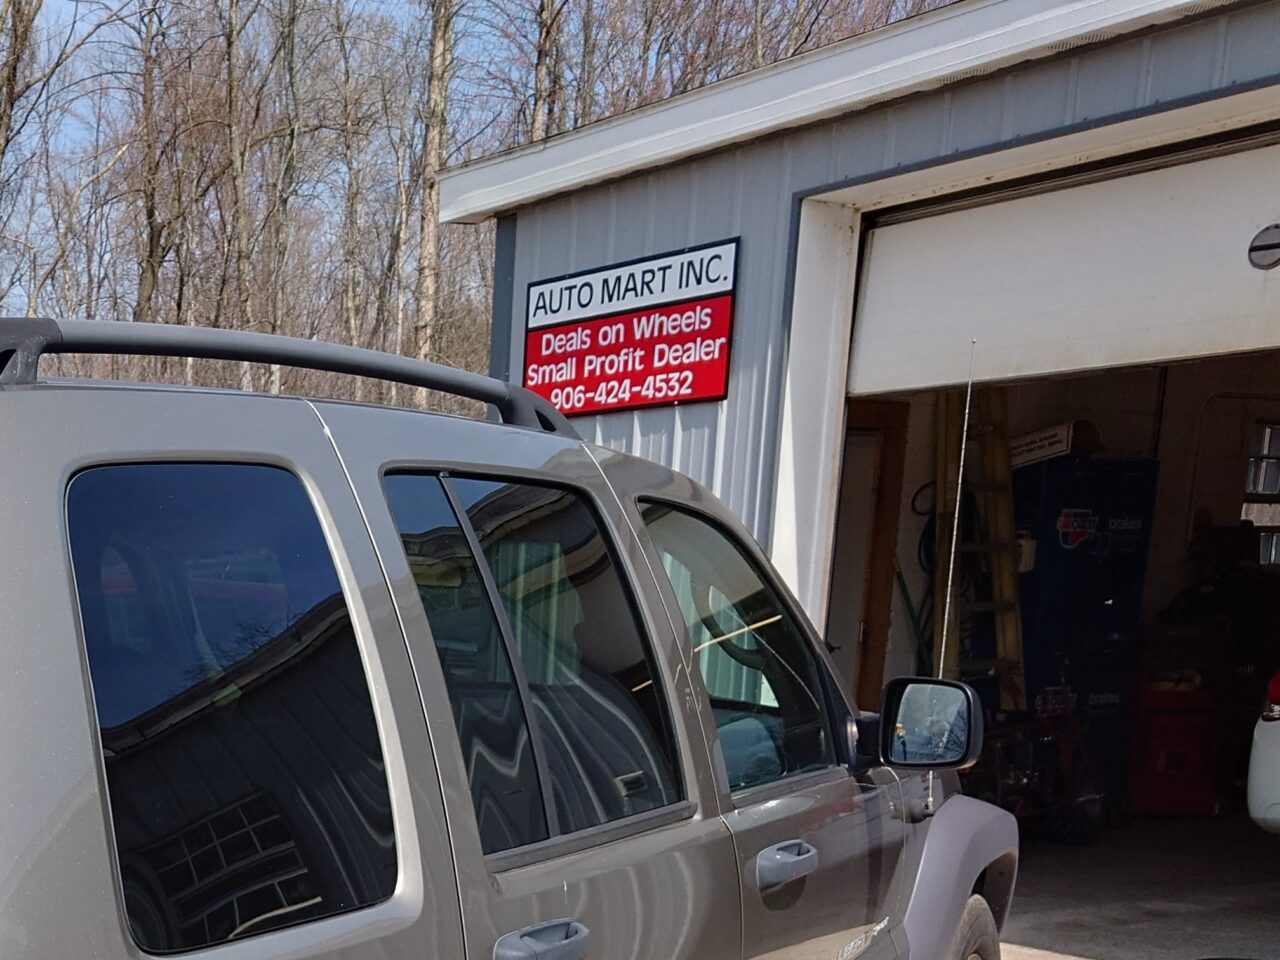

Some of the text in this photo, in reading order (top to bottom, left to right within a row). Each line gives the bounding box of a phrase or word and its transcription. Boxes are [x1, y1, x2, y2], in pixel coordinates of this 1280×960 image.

[532, 254, 728, 318] AUTO MART INC.
[541, 305, 712, 356] Deals on Wheels
[527, 335, 726, 386] Small Profit Dealer
[550, 370, 694, 411] 906-424-4532
